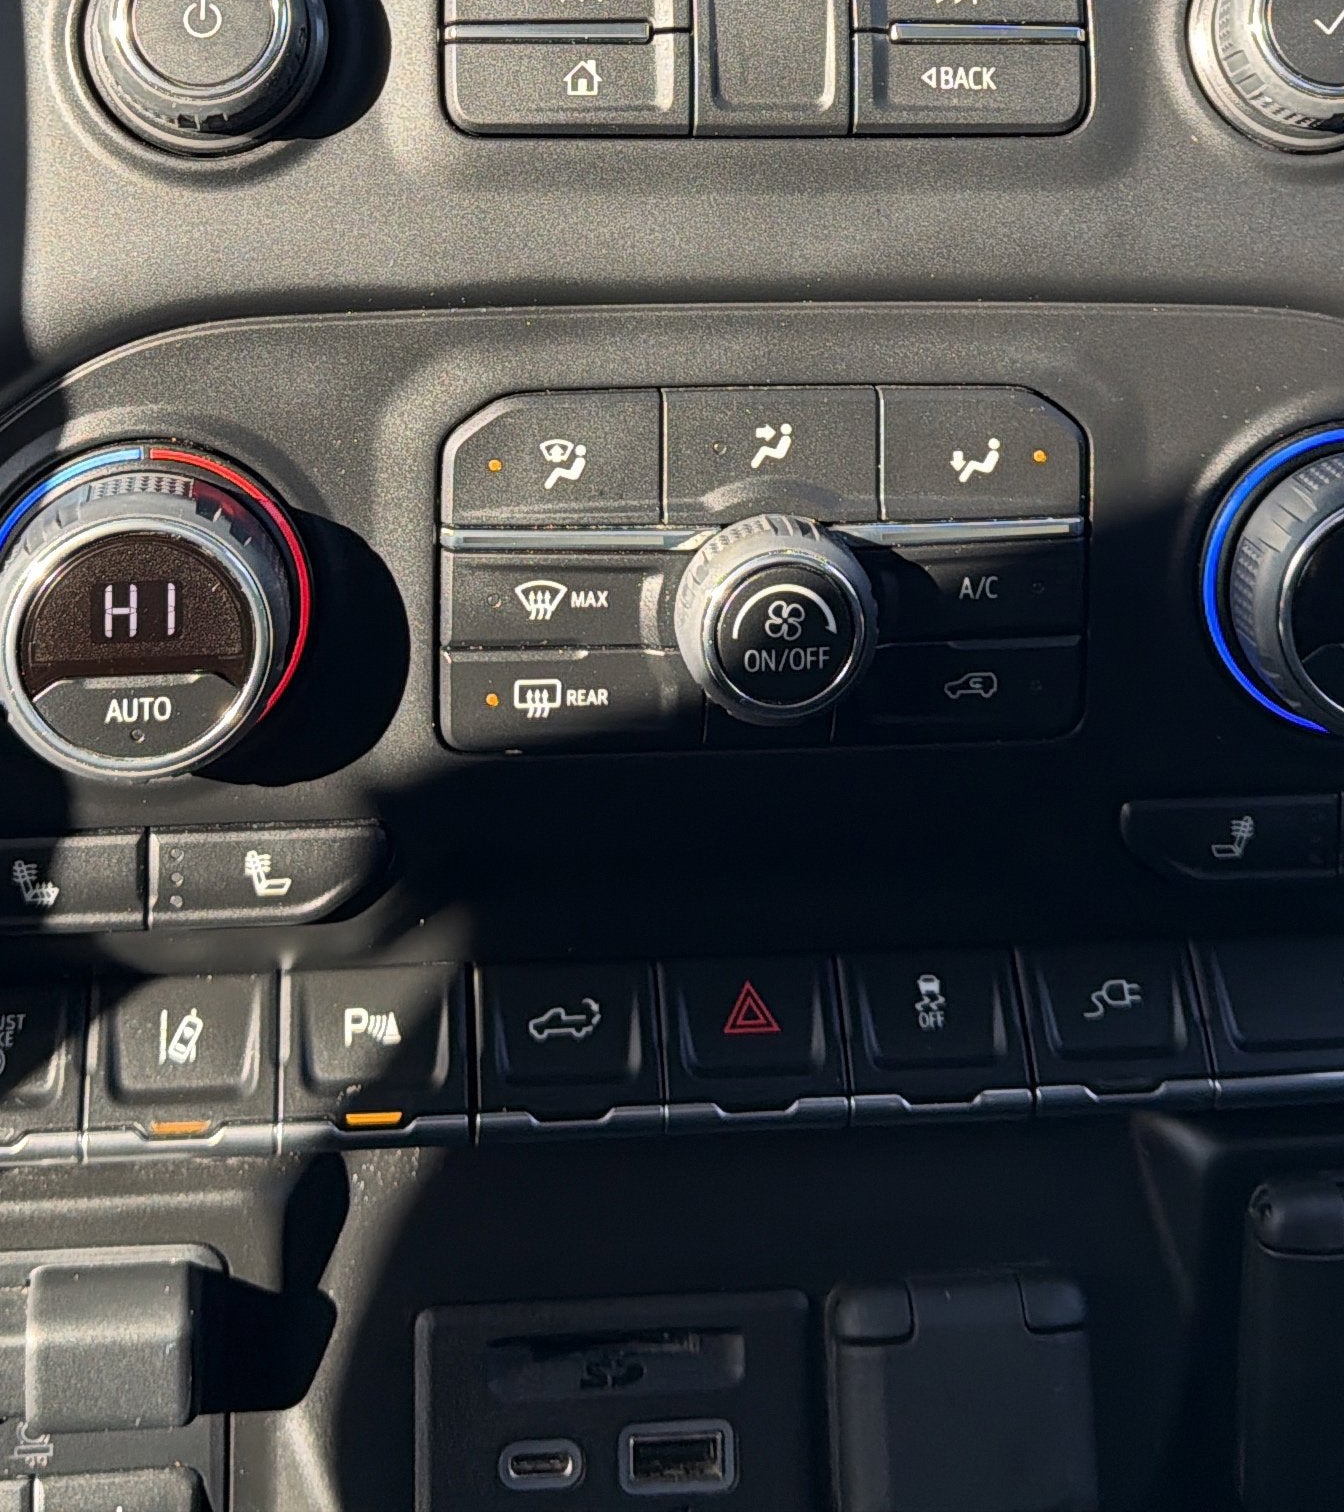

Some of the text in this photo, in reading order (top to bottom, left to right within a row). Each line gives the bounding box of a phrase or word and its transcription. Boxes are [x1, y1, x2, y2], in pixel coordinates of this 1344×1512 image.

[938, 67, 997, 90] BACK
[570, 589, 609, 610] MAX
[958, 576, 999, 600] A/C
[742, 646, 831, 674] ON/OFF
[566, 687, 609, 707] REAR
[104, 696, 173, 725] AUTO
[918, 1011, 945, 1030] OFF
